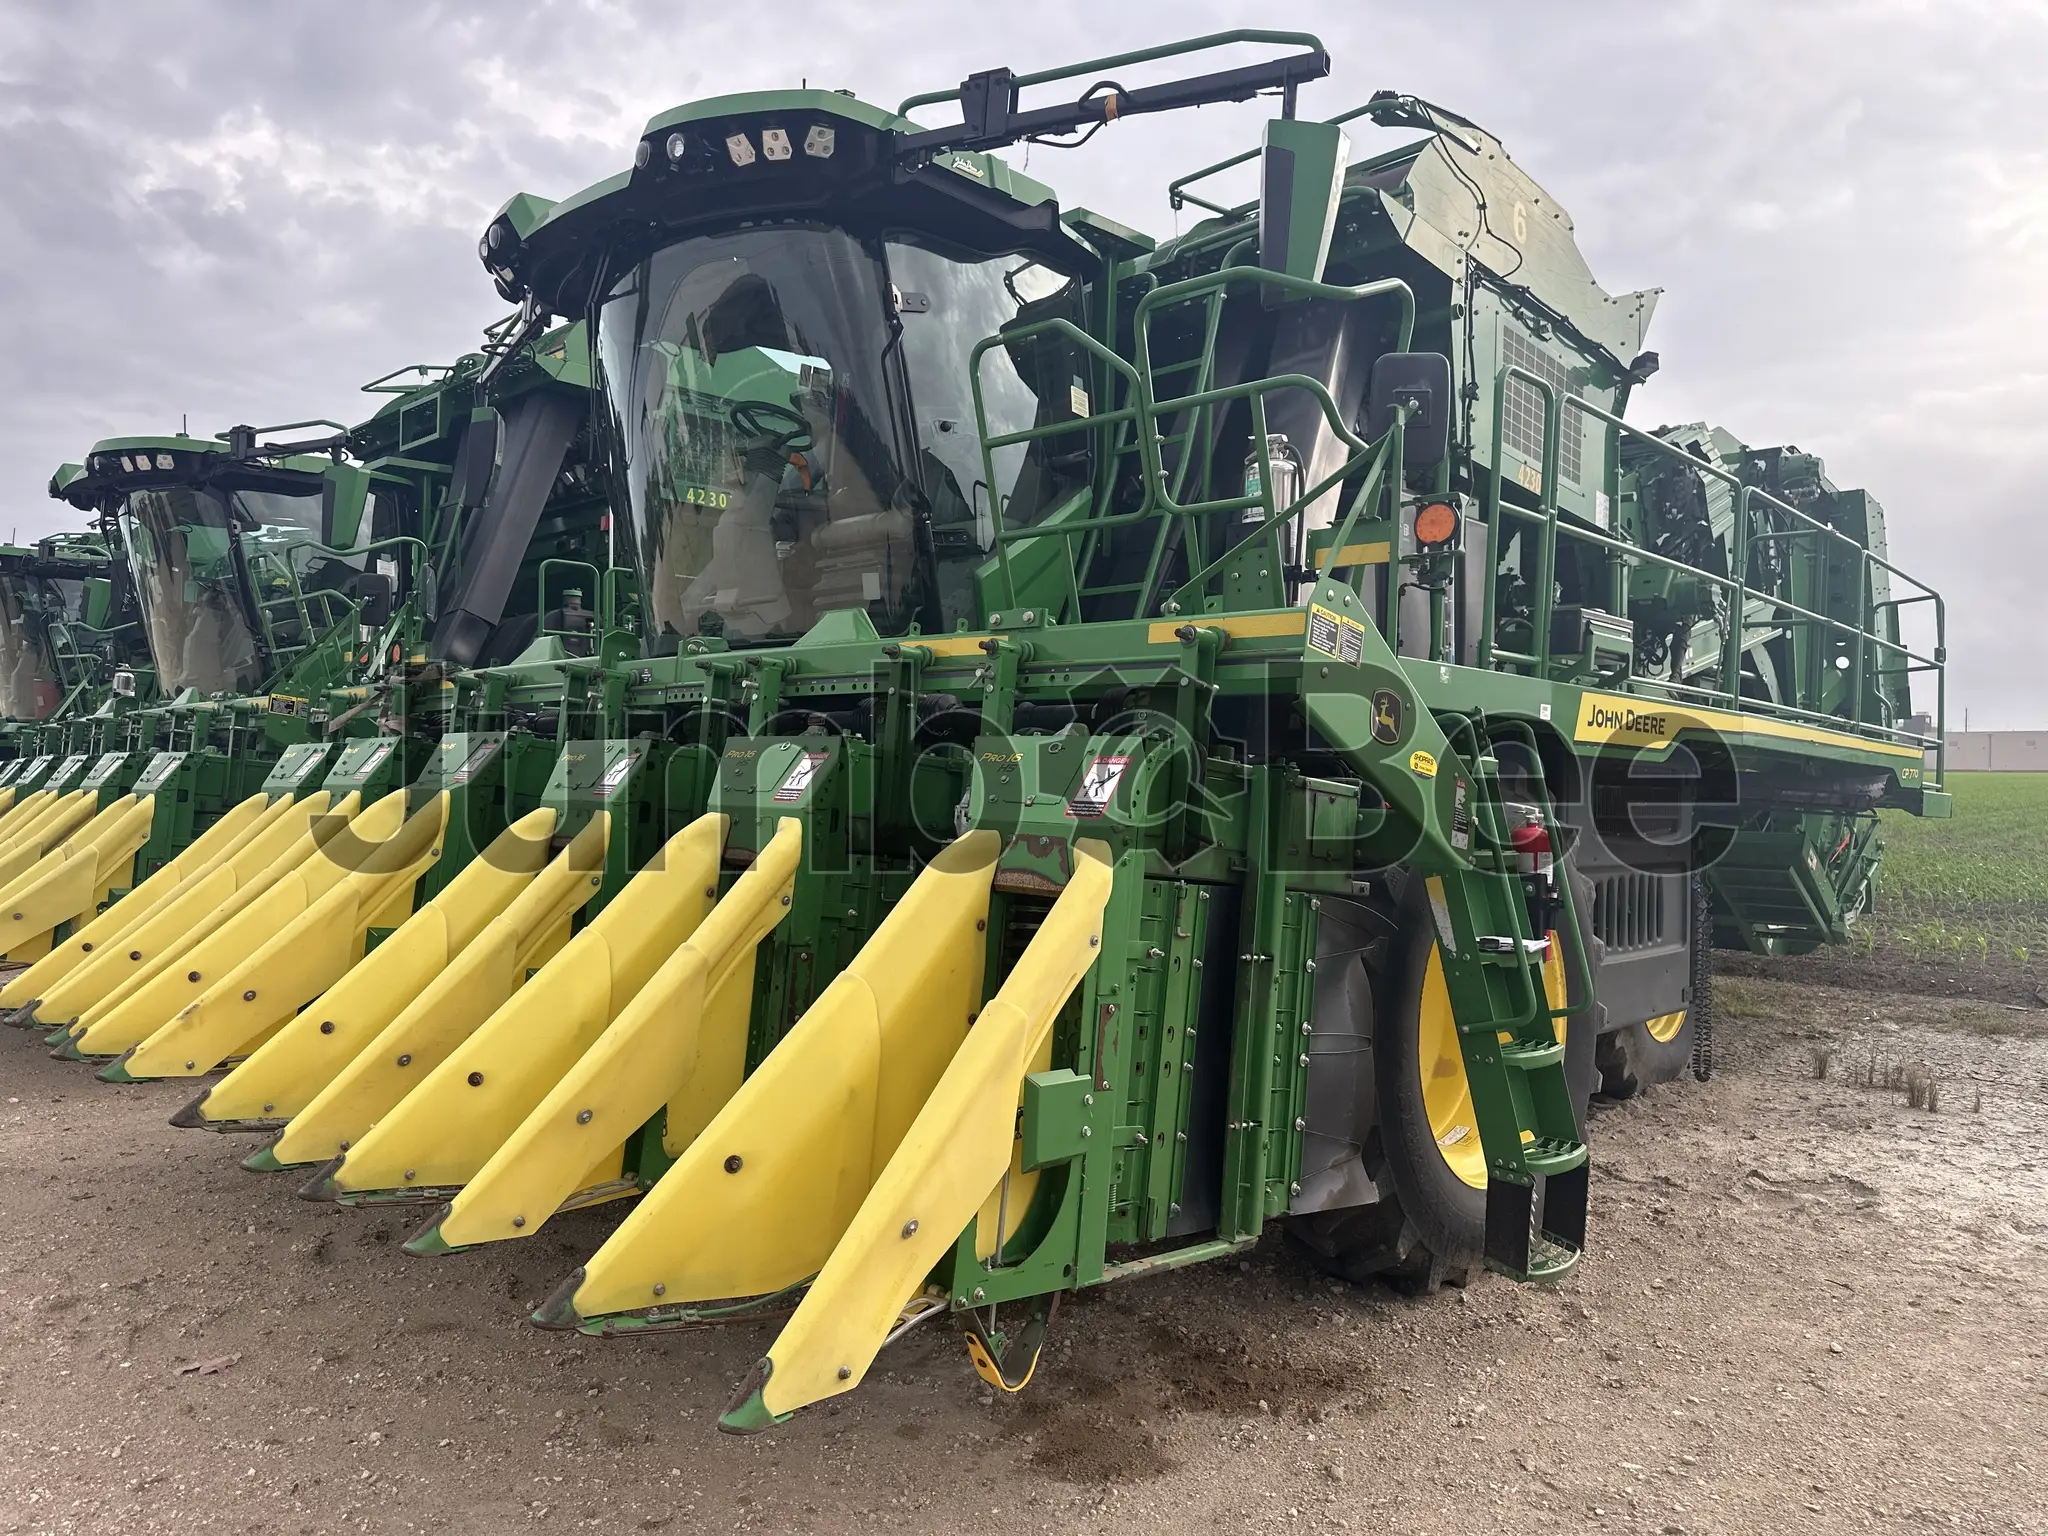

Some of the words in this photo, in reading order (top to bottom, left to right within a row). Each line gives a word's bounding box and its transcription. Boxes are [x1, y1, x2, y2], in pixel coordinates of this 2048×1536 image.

[1513, 200, 1527, 244] 6
[1518, 464, 1542, 495] 4230
[686, 487, 727, 508] 4230
[1587, 704, 1623, 730] JOHN
[1625, 709, 1666, 736] DEERE
[744, 750, 757, 758] 16
[1006, 752, 1024, 763] 16
[997, 763, 1018, 773] HS
[1909, 768, 1919, 779] 770
